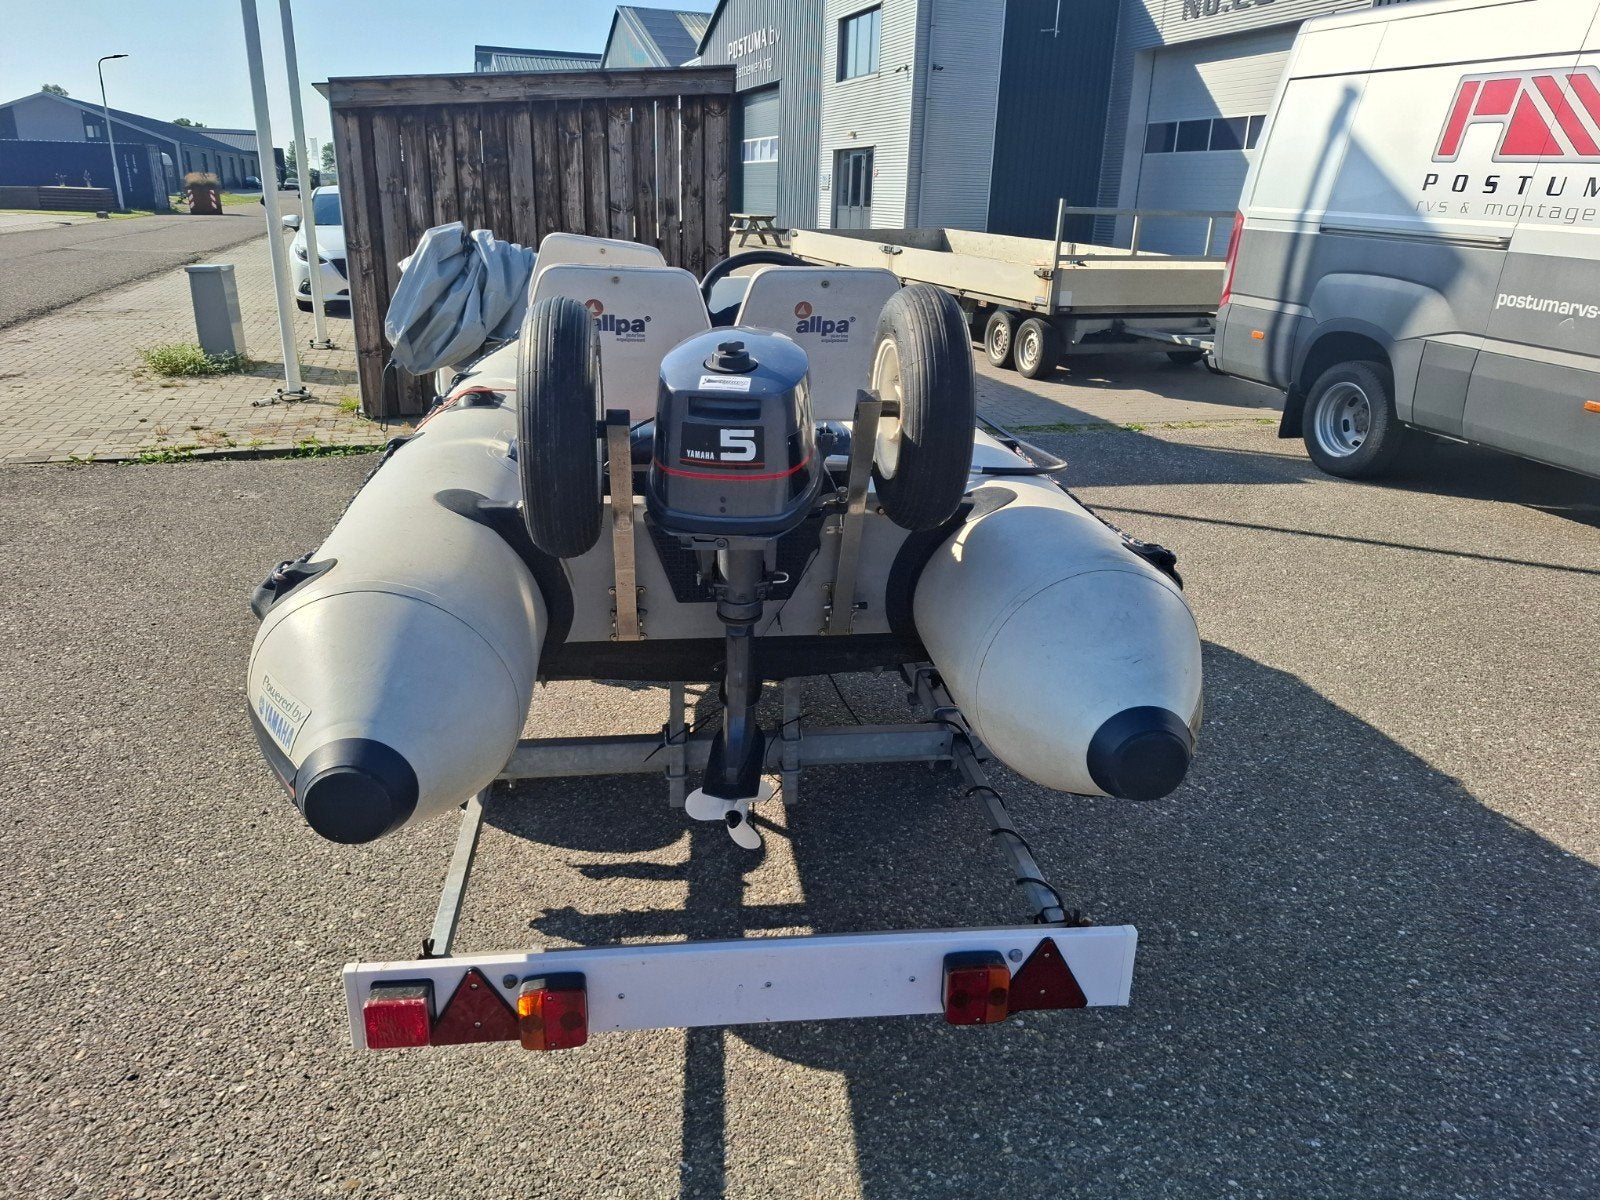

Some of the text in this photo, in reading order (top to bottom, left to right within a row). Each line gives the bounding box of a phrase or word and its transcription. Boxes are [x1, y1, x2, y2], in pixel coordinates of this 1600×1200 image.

[728, 28, 767, 61] POSTUMA
[1415, 201, 1596, 224] rvs & montage
[686, 429, 757, 462] YAMAHA 5
[262, 675, 305, 722] Powered by
[263, 701, 295, 750] YAMAHA
